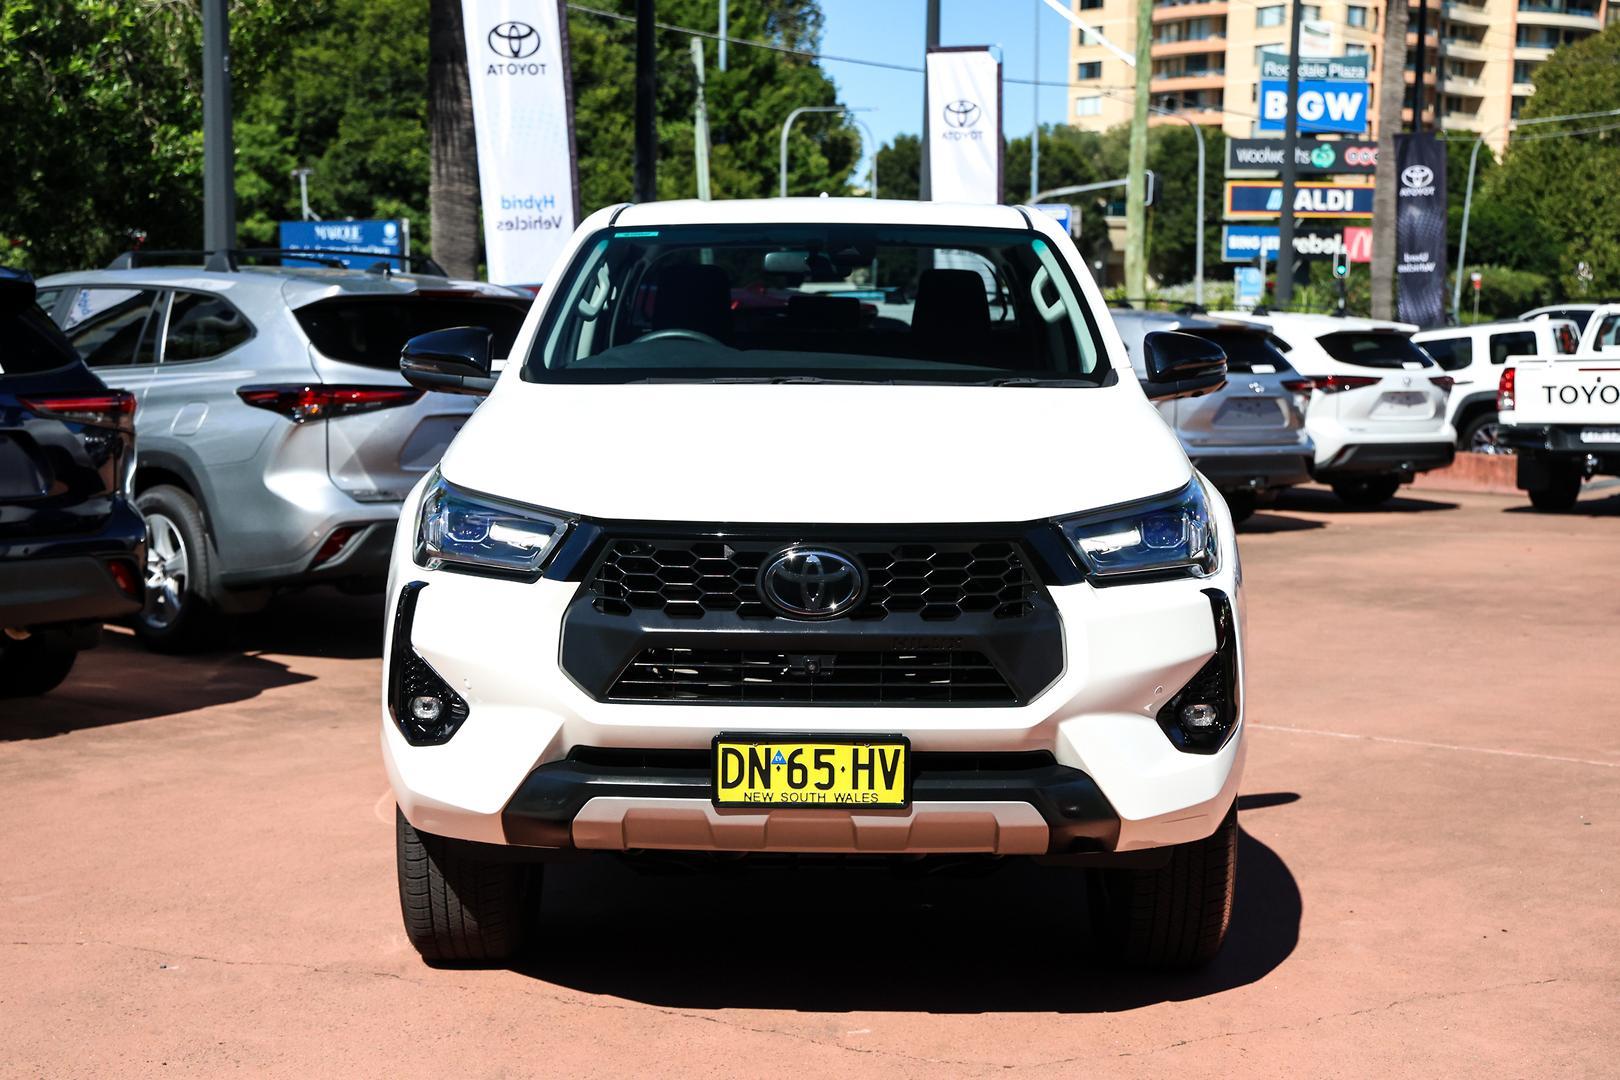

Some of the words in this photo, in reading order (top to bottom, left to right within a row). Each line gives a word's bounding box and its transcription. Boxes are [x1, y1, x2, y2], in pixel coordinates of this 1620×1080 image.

[1264, 61, 1327, 78] Rocdale
[1328, 63, 1366, 79] Plaza
[1236, 146, 1311, 165] woolwohs
[1293, 189, 1355, 211] ALDI
[744, 792, 774, 803] NEW
[780, 792, 826, 803] SOUTH
[834, 792, 879, 803] WALES
